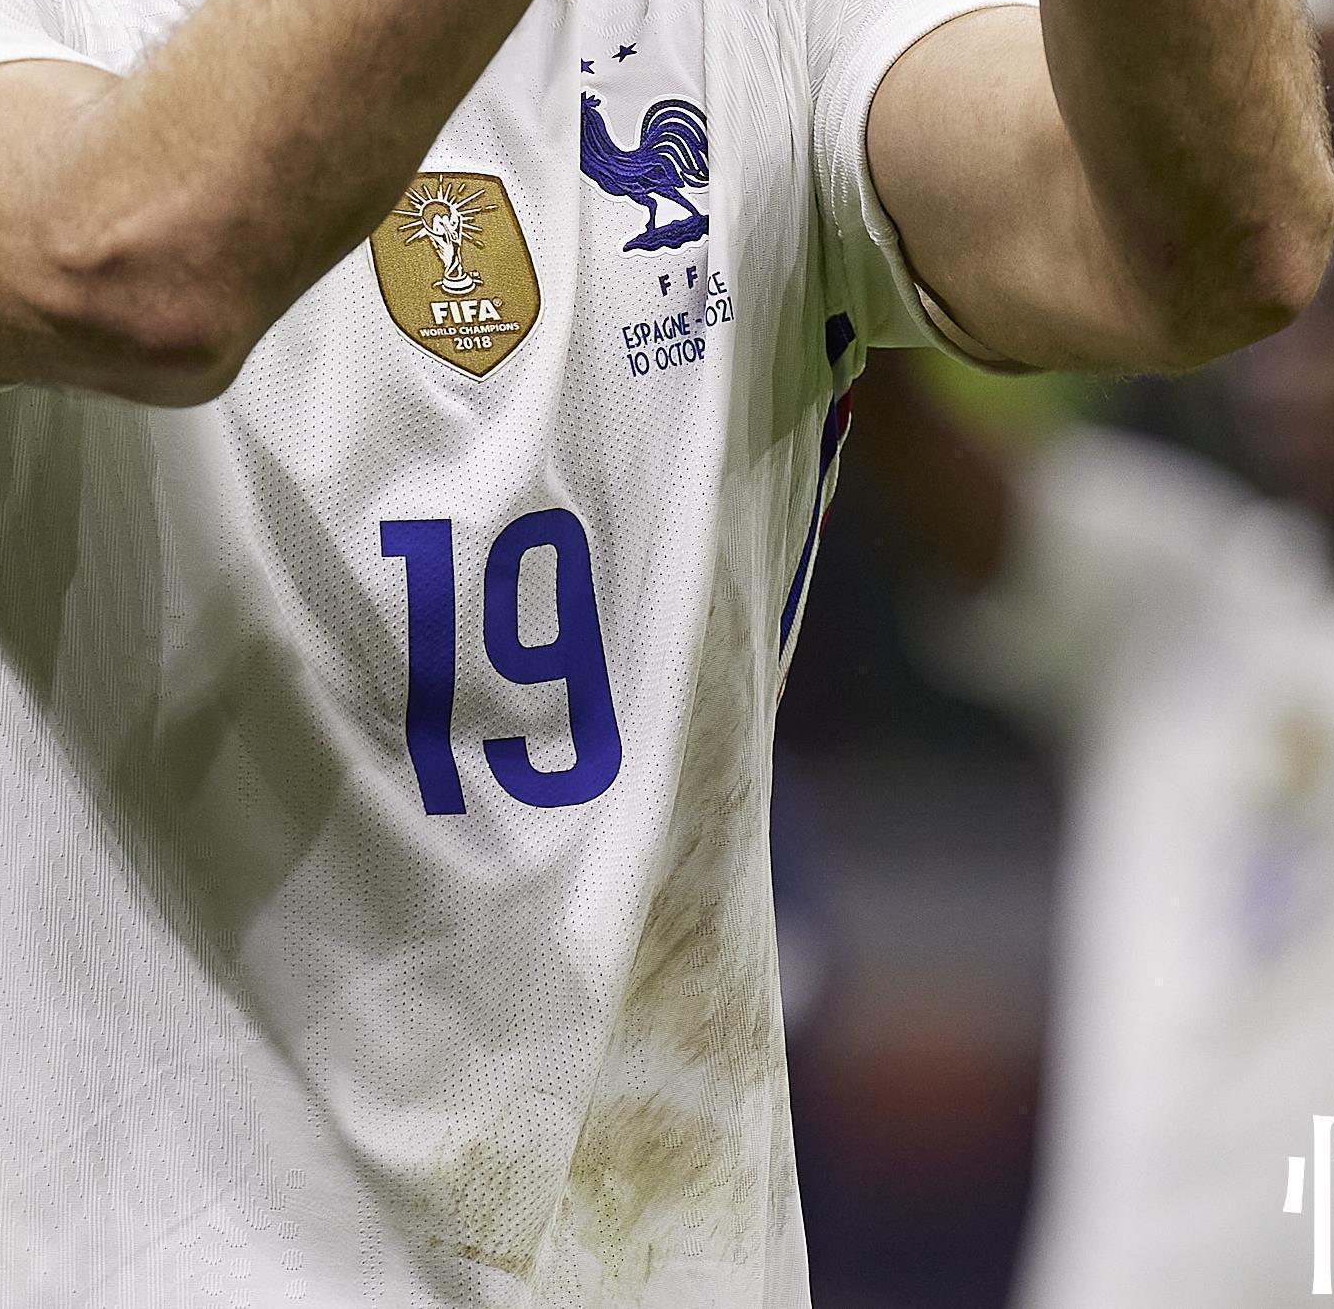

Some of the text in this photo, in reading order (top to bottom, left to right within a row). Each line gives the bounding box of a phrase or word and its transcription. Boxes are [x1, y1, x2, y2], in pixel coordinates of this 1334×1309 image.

[430, 299, 501, 325] FIFA
[419, 322, 521, 337] WORLD CHAMPIONS
[453, 335, 493, 350] 2018
[621, 311, 691, 350] ESPAGNE
[626, 351, 650, 378] 10
[705, 296, 735, 327] 021
[379, 508, 623, 816] 19
